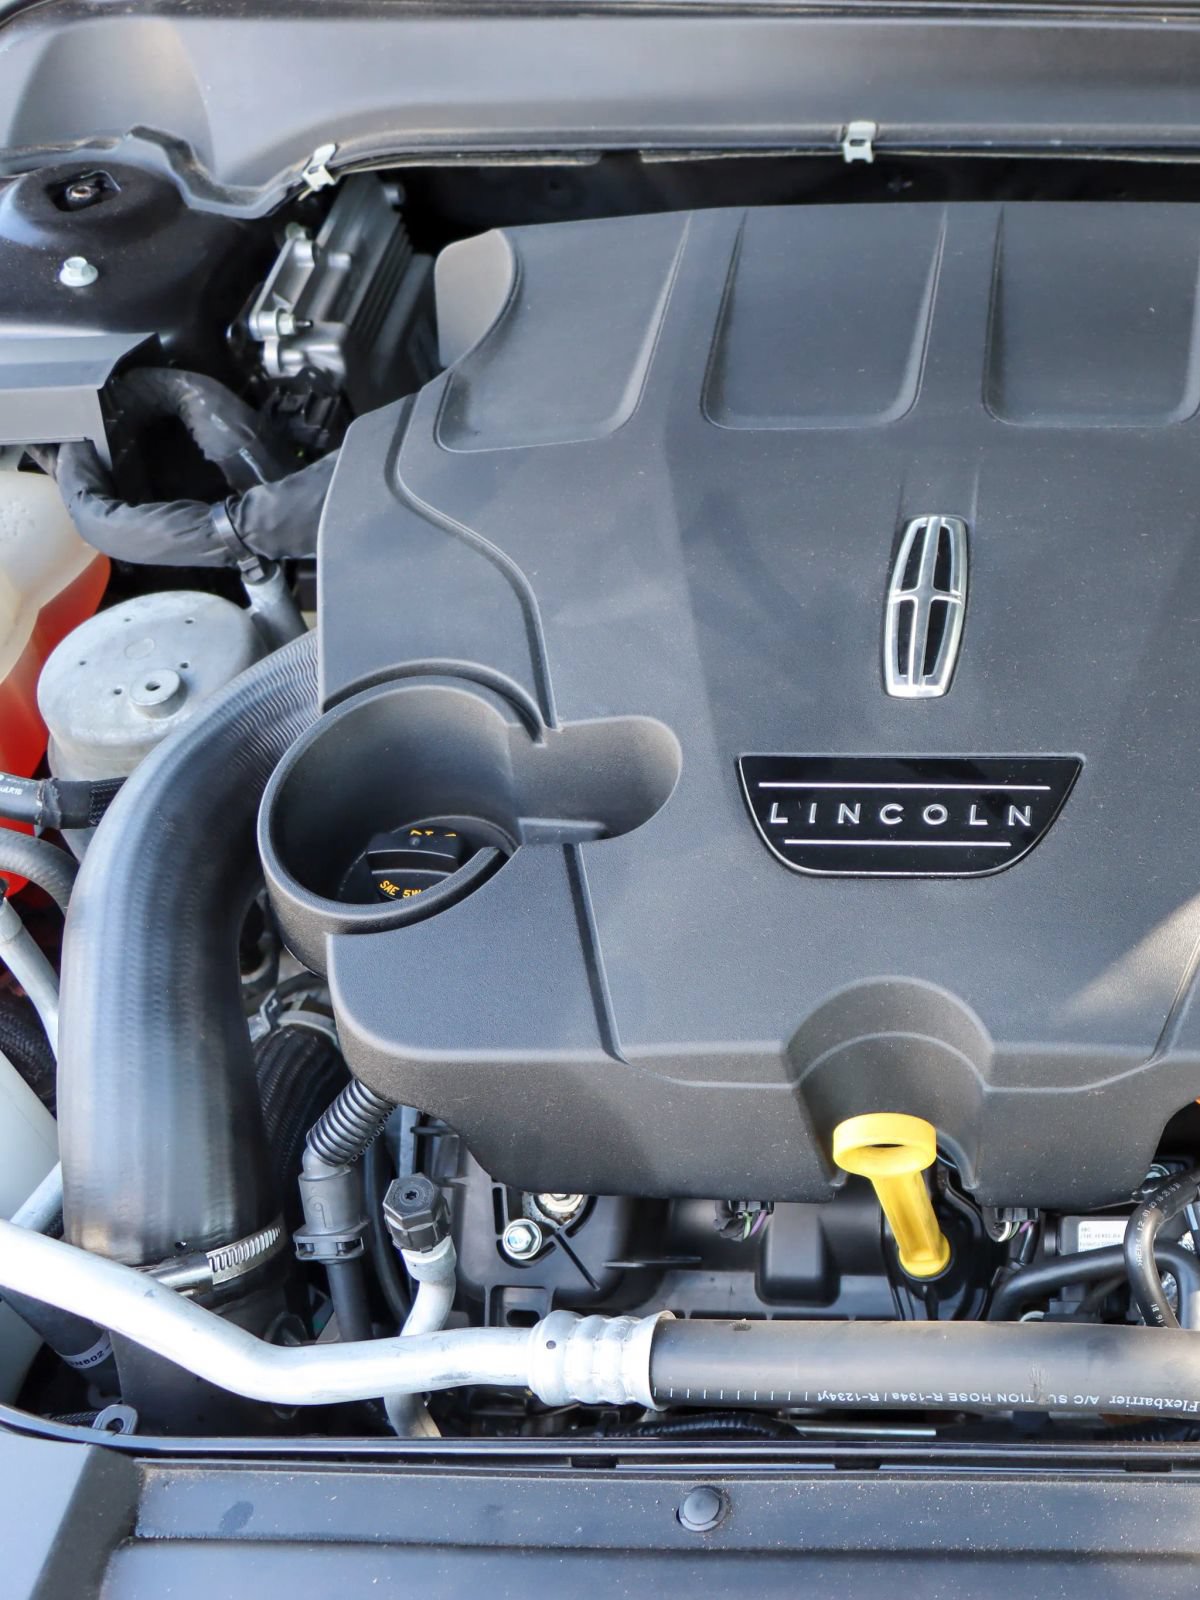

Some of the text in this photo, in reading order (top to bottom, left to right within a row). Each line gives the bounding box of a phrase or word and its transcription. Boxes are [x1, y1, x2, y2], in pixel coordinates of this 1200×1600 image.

[769, 802, 1032, 827] LINCOLN
[380, 880, 400, 896] SAE
[817, 1390, 879, 1402] R-1234yf
[892, 1392, 944, 1402] R-134a
[949, 1392, 992, 1402] HOSE
[997, 1393, 1067, 1404] SUTION
[1073, 1394, 1100, 1405] A/C
[1109, 1395, 1200, 1412] Flexbarrier
